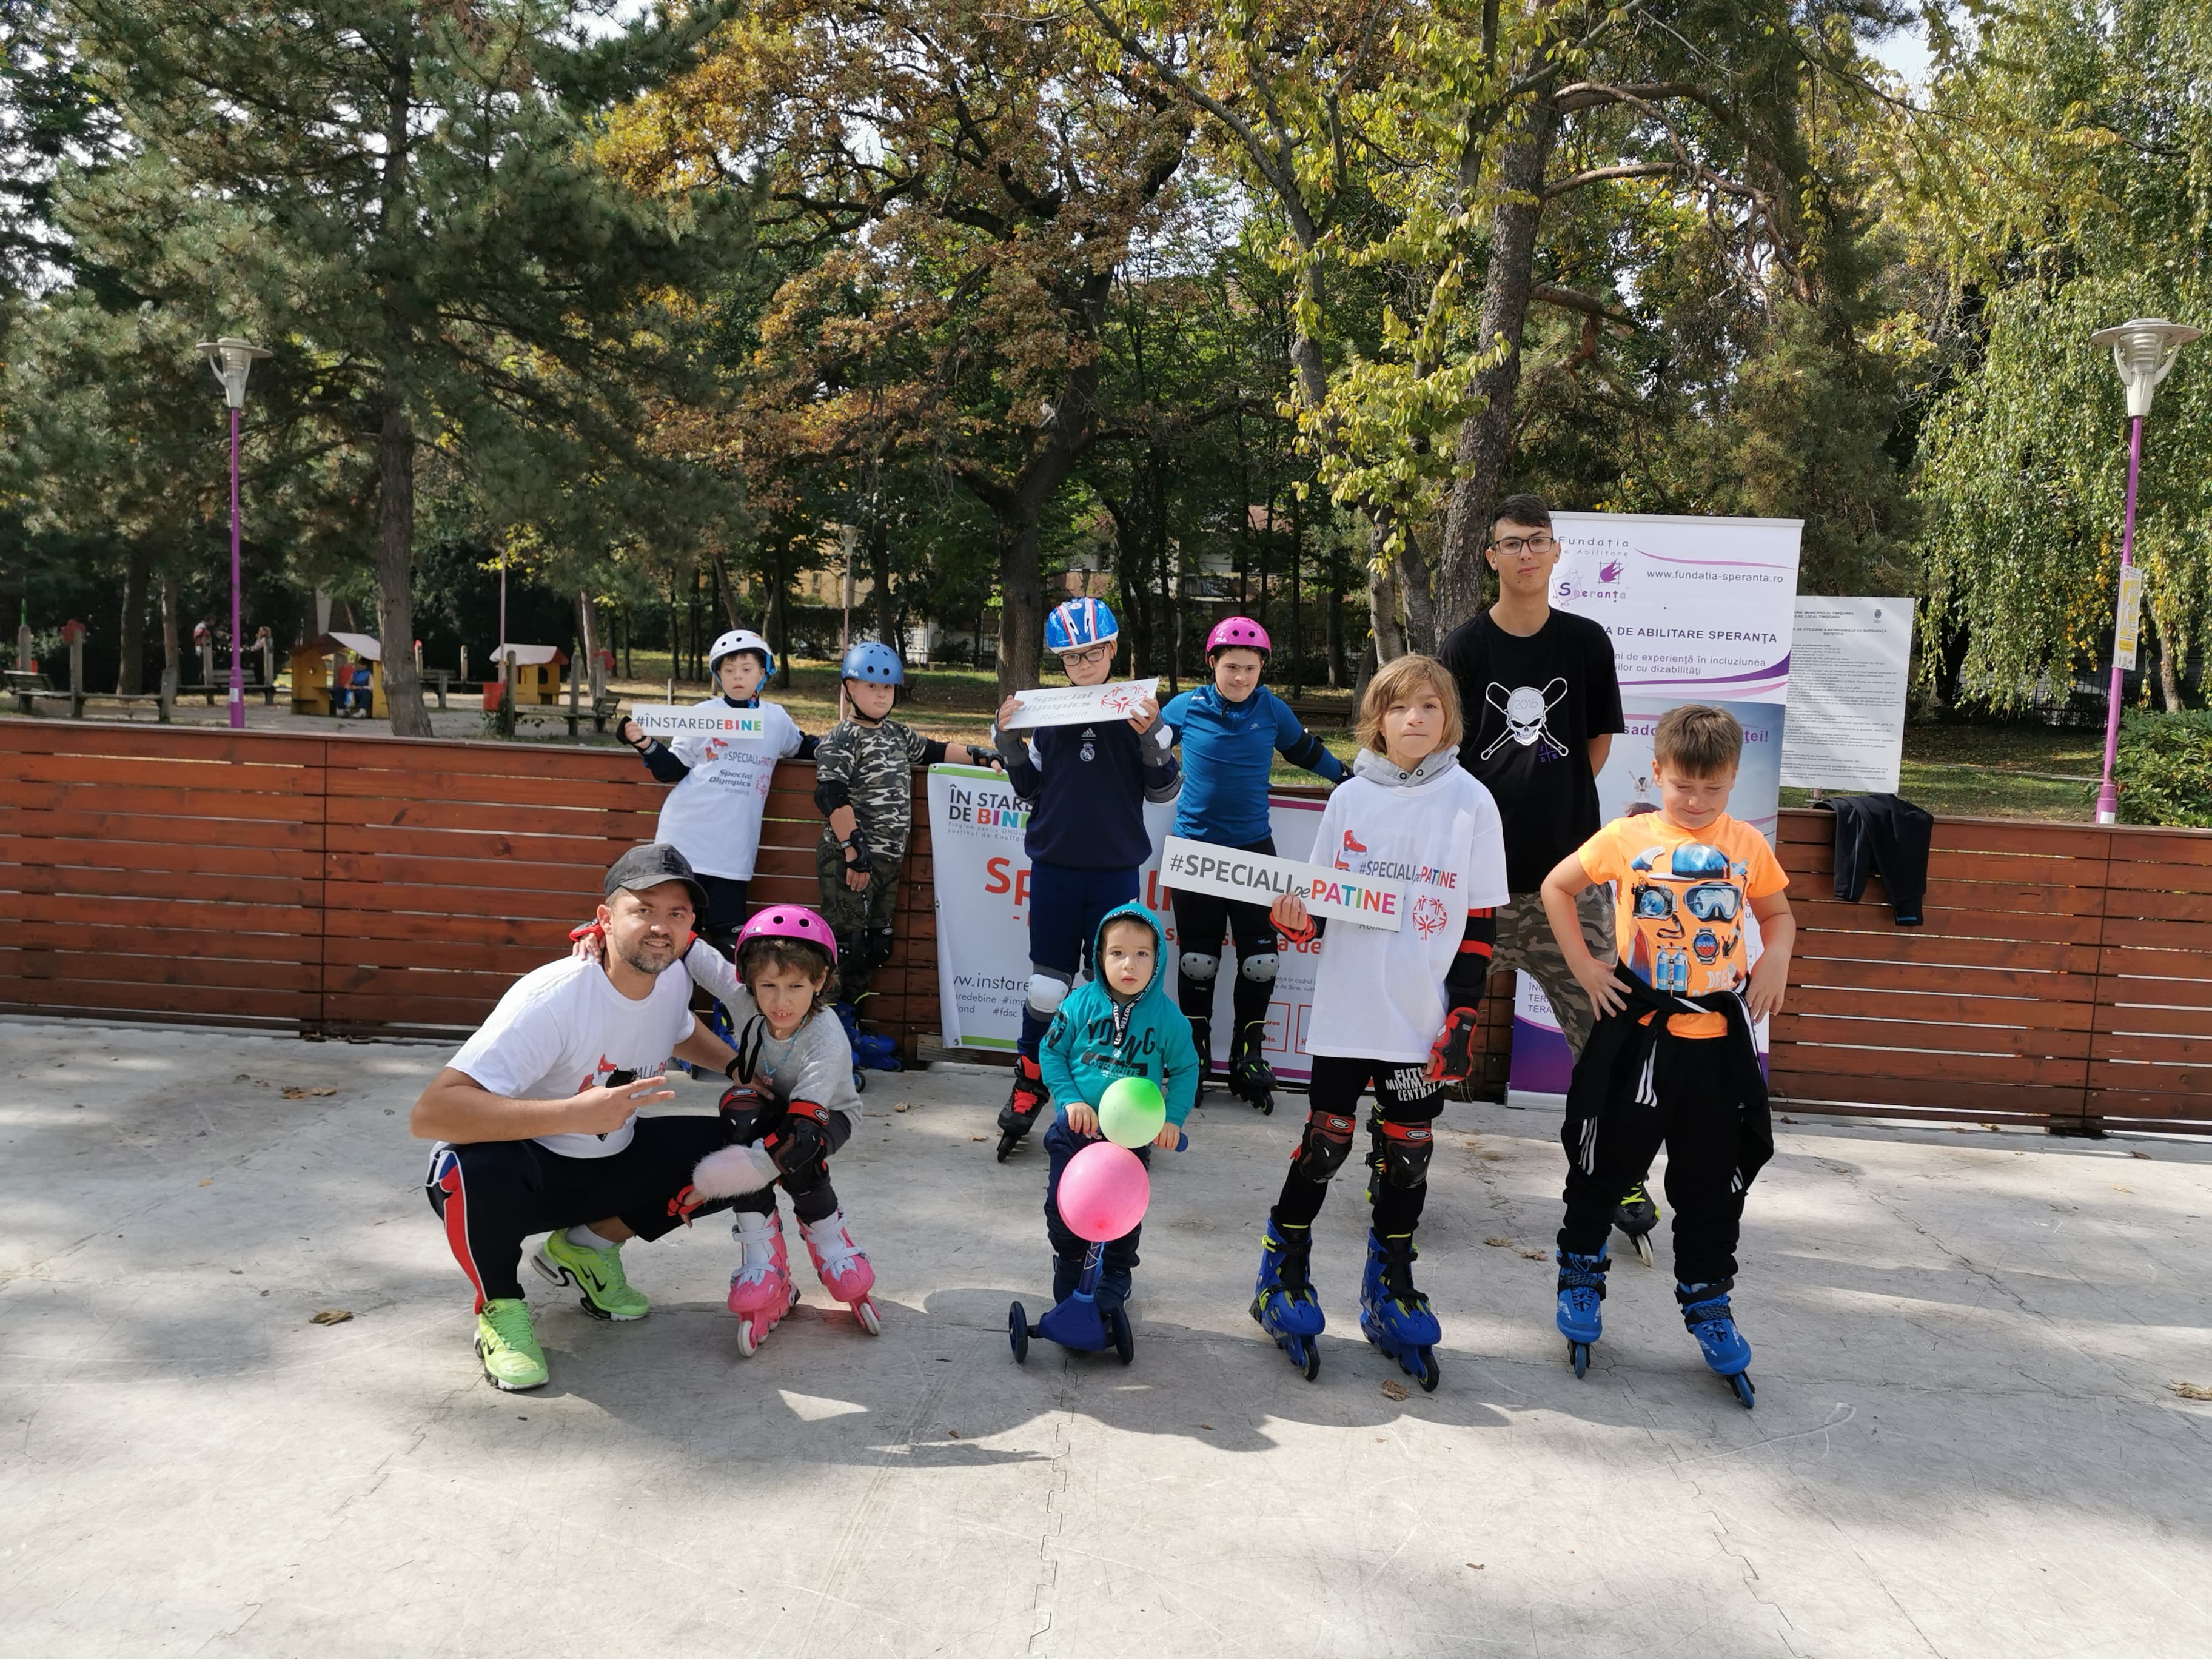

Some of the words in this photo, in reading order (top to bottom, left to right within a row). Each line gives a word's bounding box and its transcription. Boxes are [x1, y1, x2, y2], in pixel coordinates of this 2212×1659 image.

[1647, 570, 1783, 583] www.fundatia-speranta.ro
[1617, 627, 1634, 635] DE
[1637, 628, 1703, 639] ABILITARE
[1698, 655, 1706, 664] în
[1710, 657, 1766, 666] incluziunea
[1033, 691, 1094, 703] Special
[1515, 698, 1539, 709] 2015
[1041, 709, 1087, 720] Romania
[719, 769, 753, 779] Special
[709, 776, 751, 787] Olympics
[949, 783, 971, 805] ÎN
[949, 805, 971, 822] DE
[948, 821, 974, 830] Program
[993, 1007, 1018, 1017] #fdsc
[1087, 1019, 1155, 1066] YONG
[1398, 1082, 1437, 1101] CENTRAL
